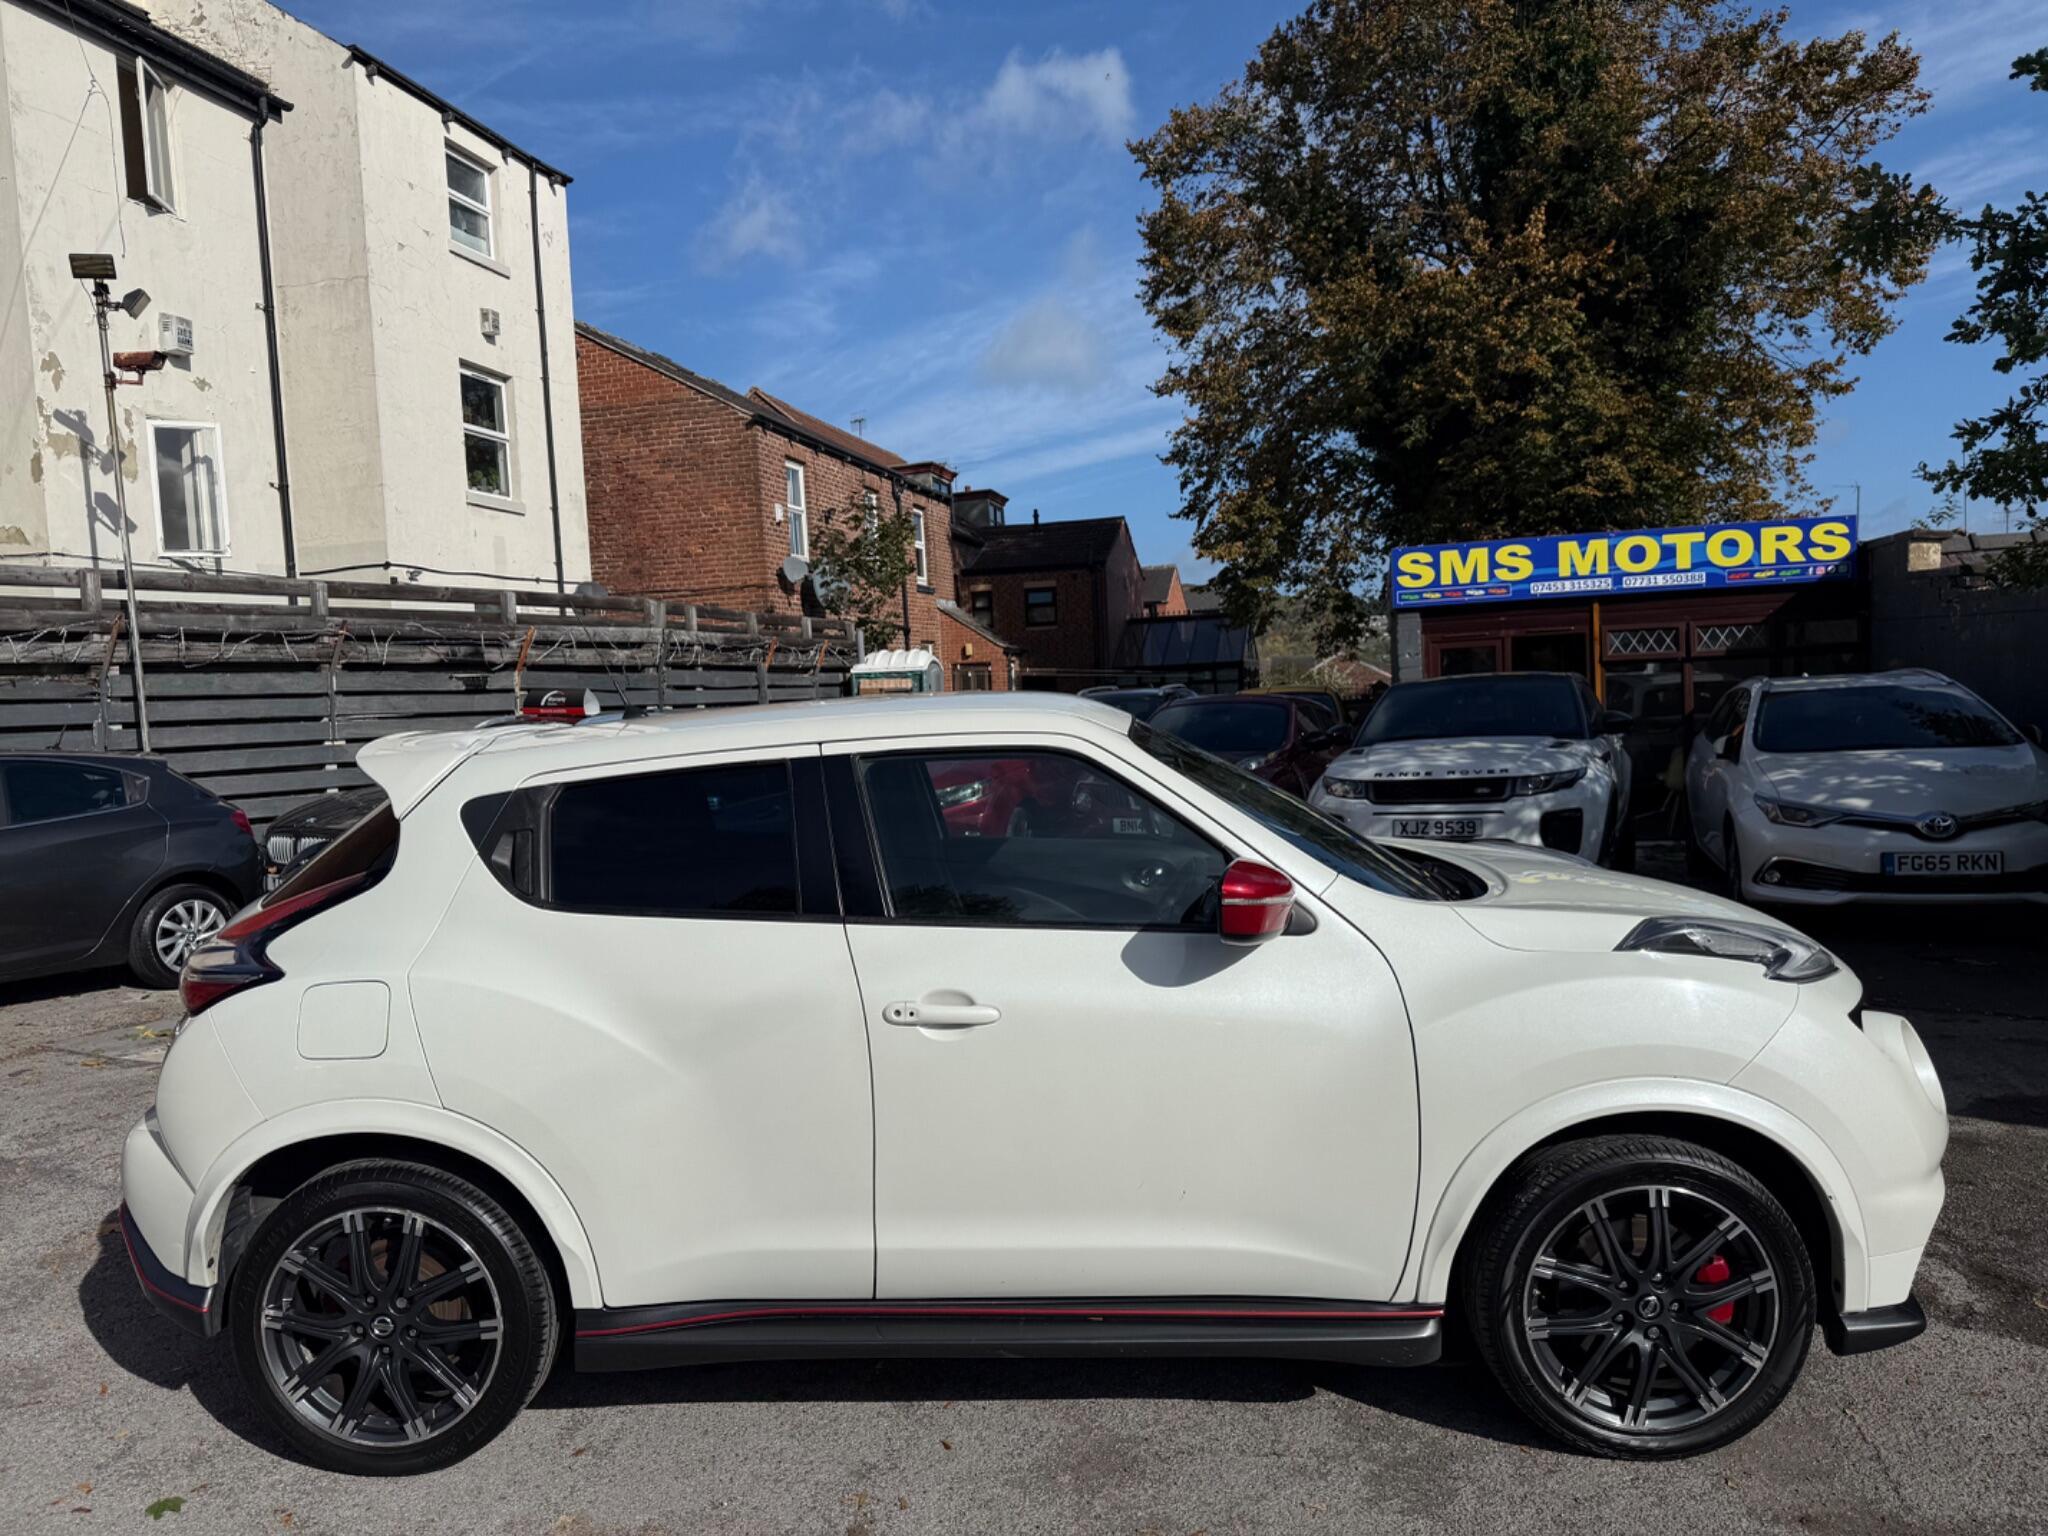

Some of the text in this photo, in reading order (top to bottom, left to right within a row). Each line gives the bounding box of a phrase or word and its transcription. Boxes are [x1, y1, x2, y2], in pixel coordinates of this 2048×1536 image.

[1397, 522, 1851, 587] SMS MOTORS
[1532, 578, 1610, 593] 07453 315325
[1624, 573, 1704, 587] 07731 550388
[1400, 818, 1477, 835] XJZ 9539
[1898, 854, 1997, 872] FG65 RKN
